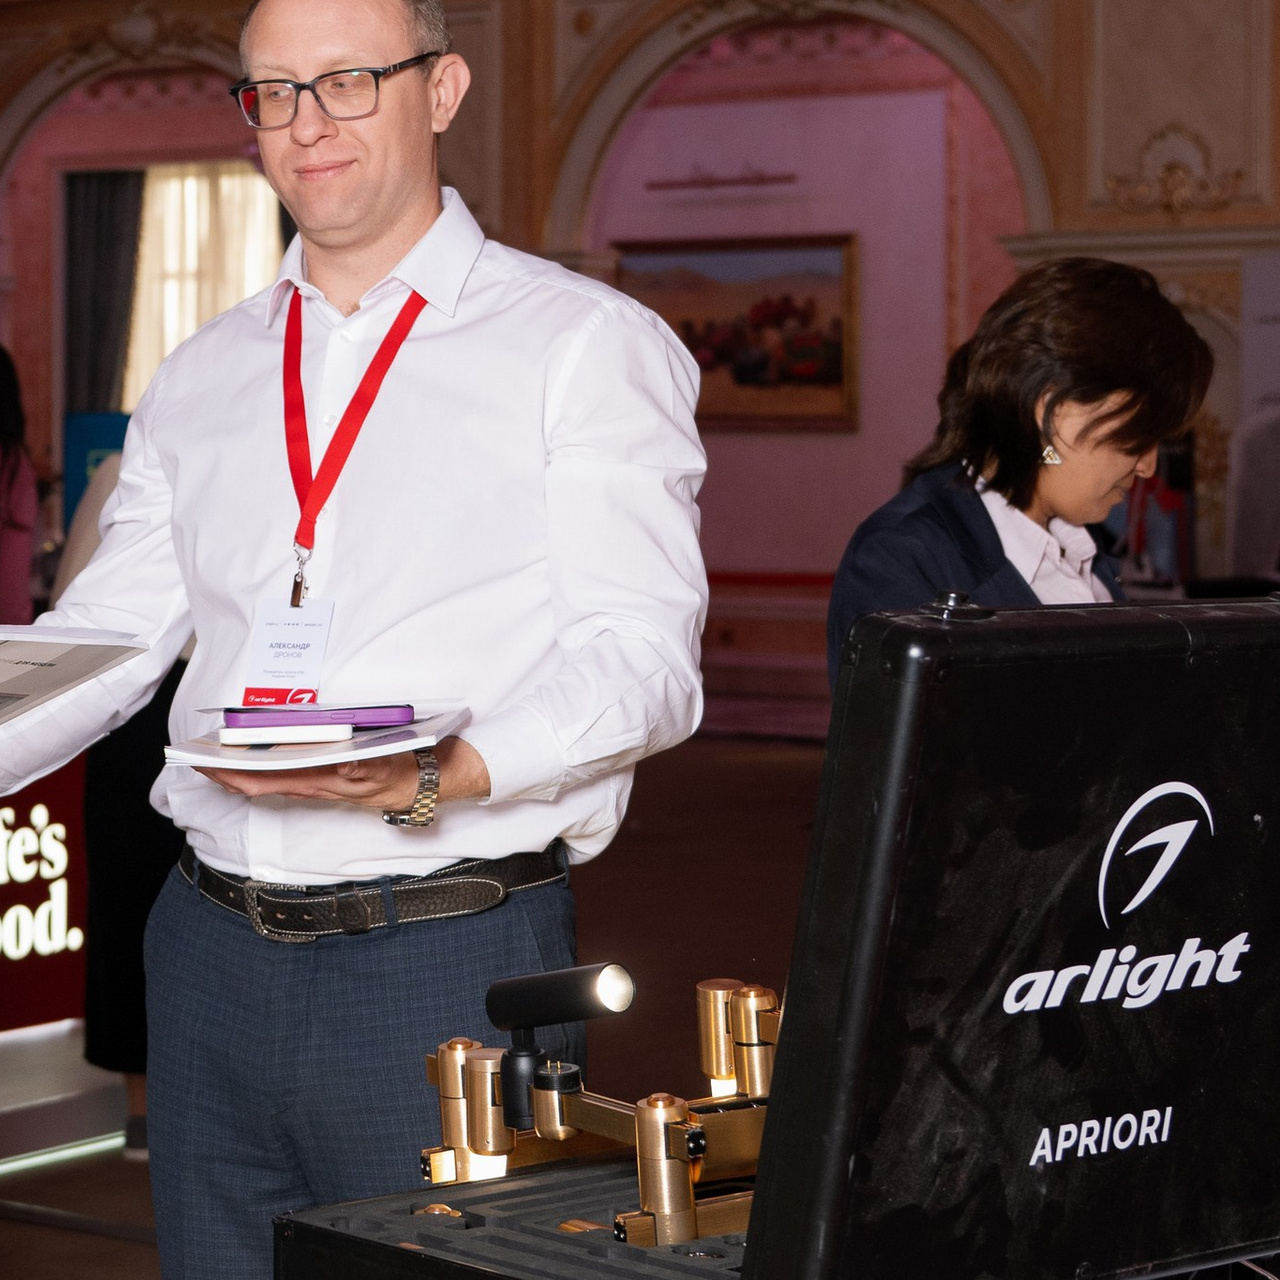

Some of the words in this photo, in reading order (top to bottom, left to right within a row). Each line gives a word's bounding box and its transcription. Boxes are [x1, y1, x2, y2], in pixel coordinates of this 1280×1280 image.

[269, 642, 311, 650] АЛЕКСАНДР
[273, 651, 303, 659] ДРОНОВ
[1002, 932, 1251, 1014] arlight
[1029, 1106, 1173, 1166] APRIORI
